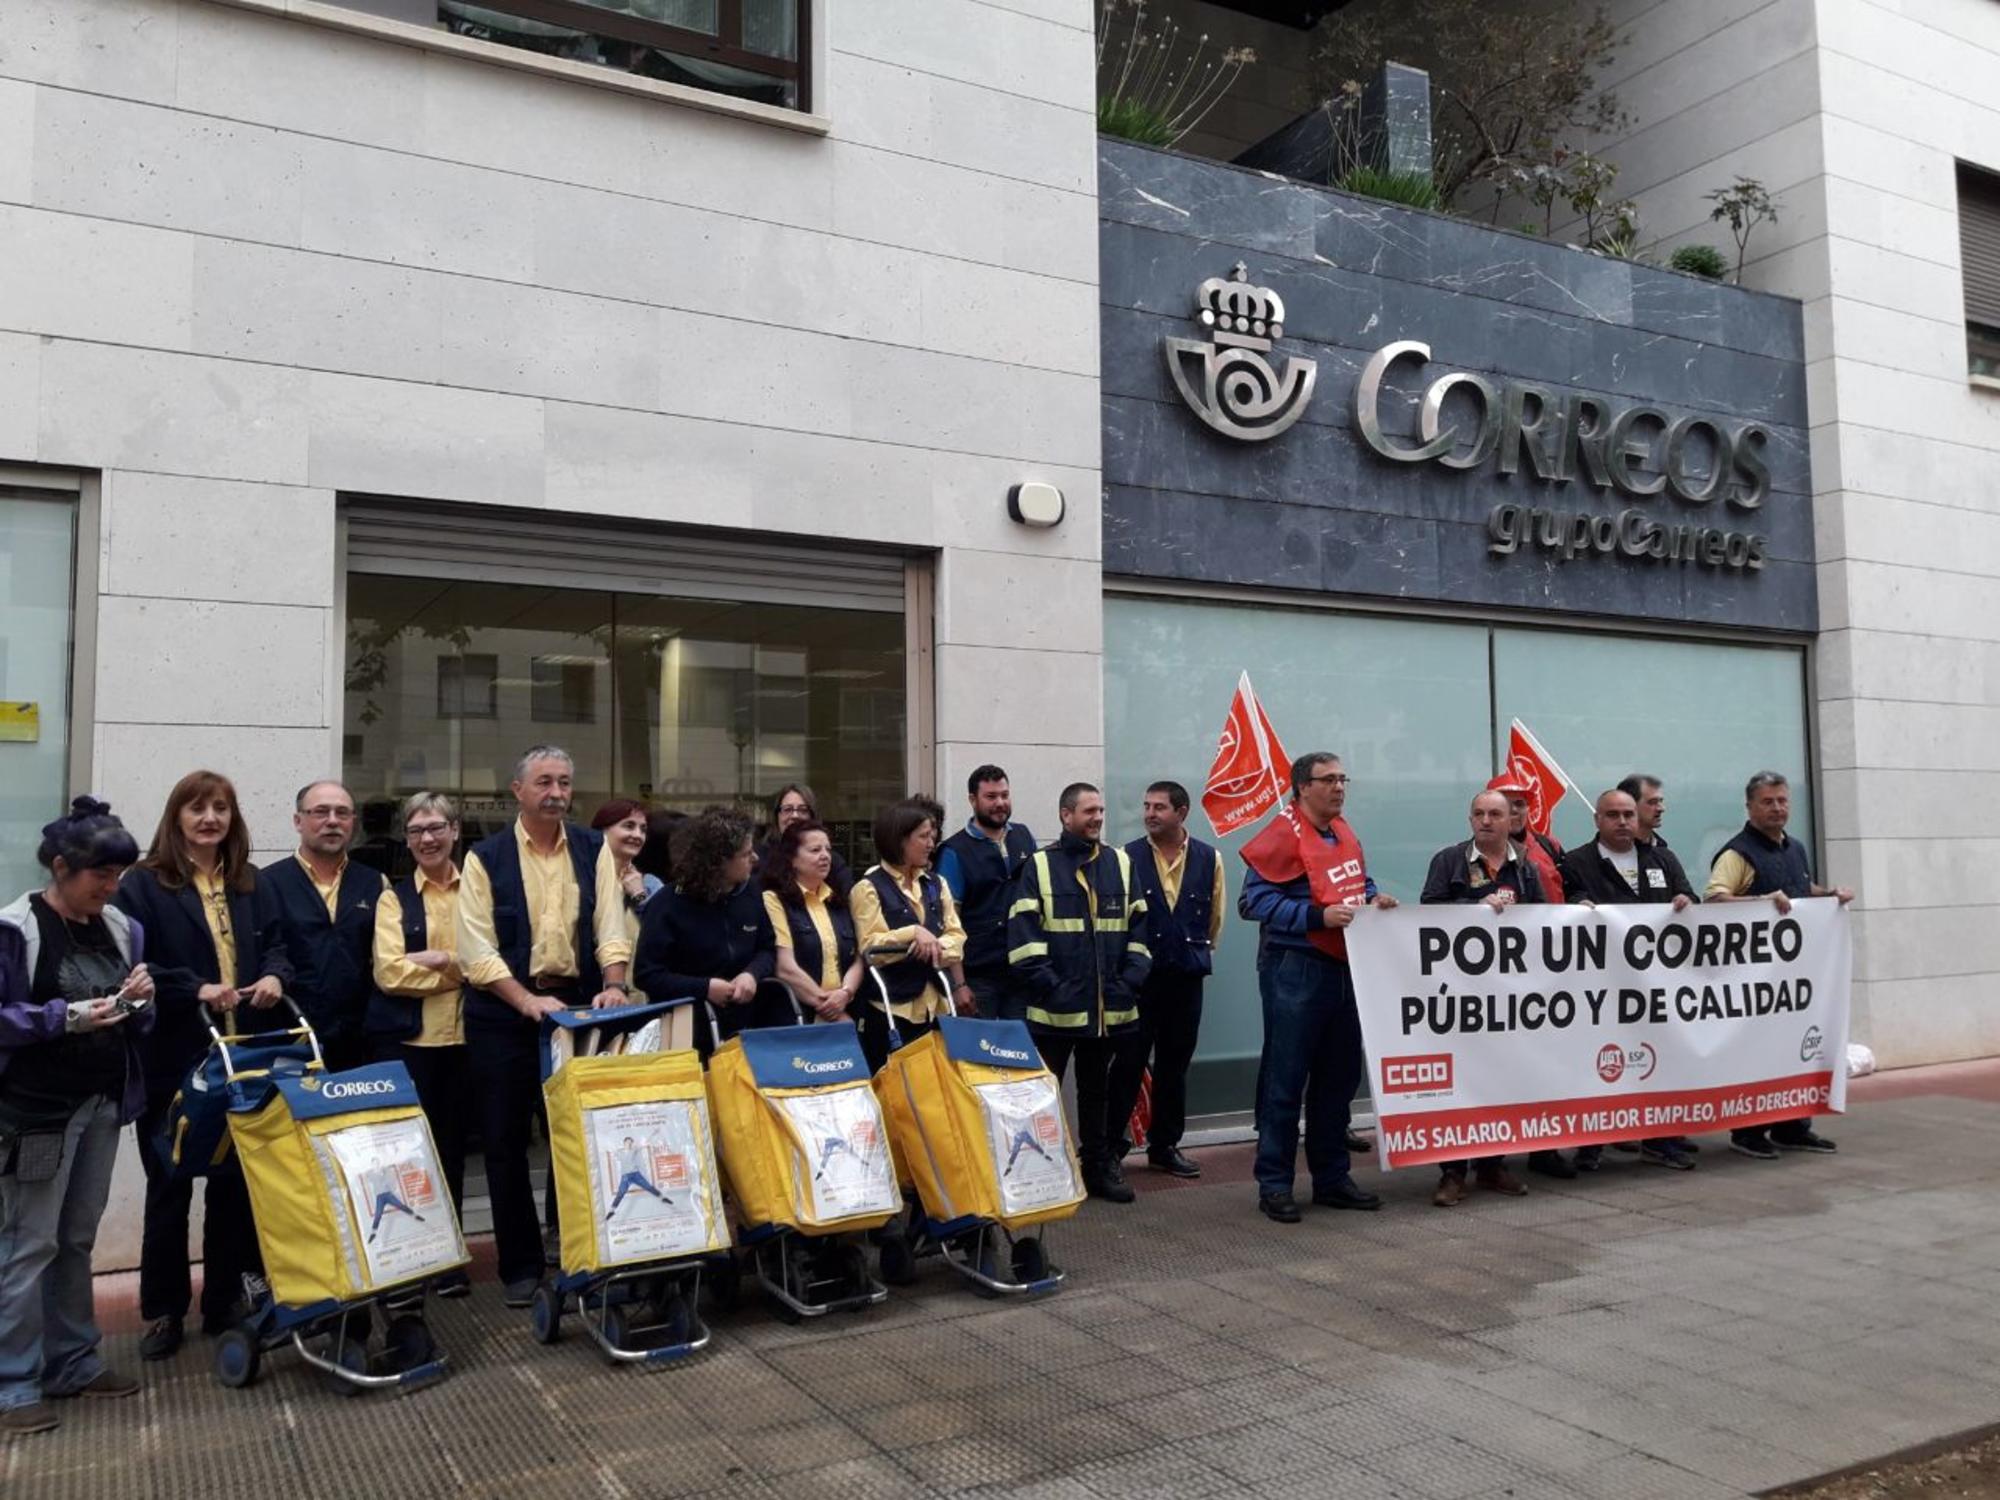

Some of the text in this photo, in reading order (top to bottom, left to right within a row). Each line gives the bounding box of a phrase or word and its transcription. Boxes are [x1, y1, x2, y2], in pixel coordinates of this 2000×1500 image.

[1356, 340, 1772, 509] CORREOS
[1488, 503, 1768, 569] grupoCorreos
[1419, 918, 1803, 975] POR UN CORREO
[1401, 978, 1812, 1035] PÚBLICO Y DE CALIDAD
[322, 1079, 396, 1099] CORREOS
[804, 1058, 854, 1073] CORREOS
[1386, 1062, 1447, 1085] CCOO
[1384, 1085, 1831, 1153] MÁS SALARIO, MÁS Y MEJOR EMPLEO, MÁS DERECHOS
